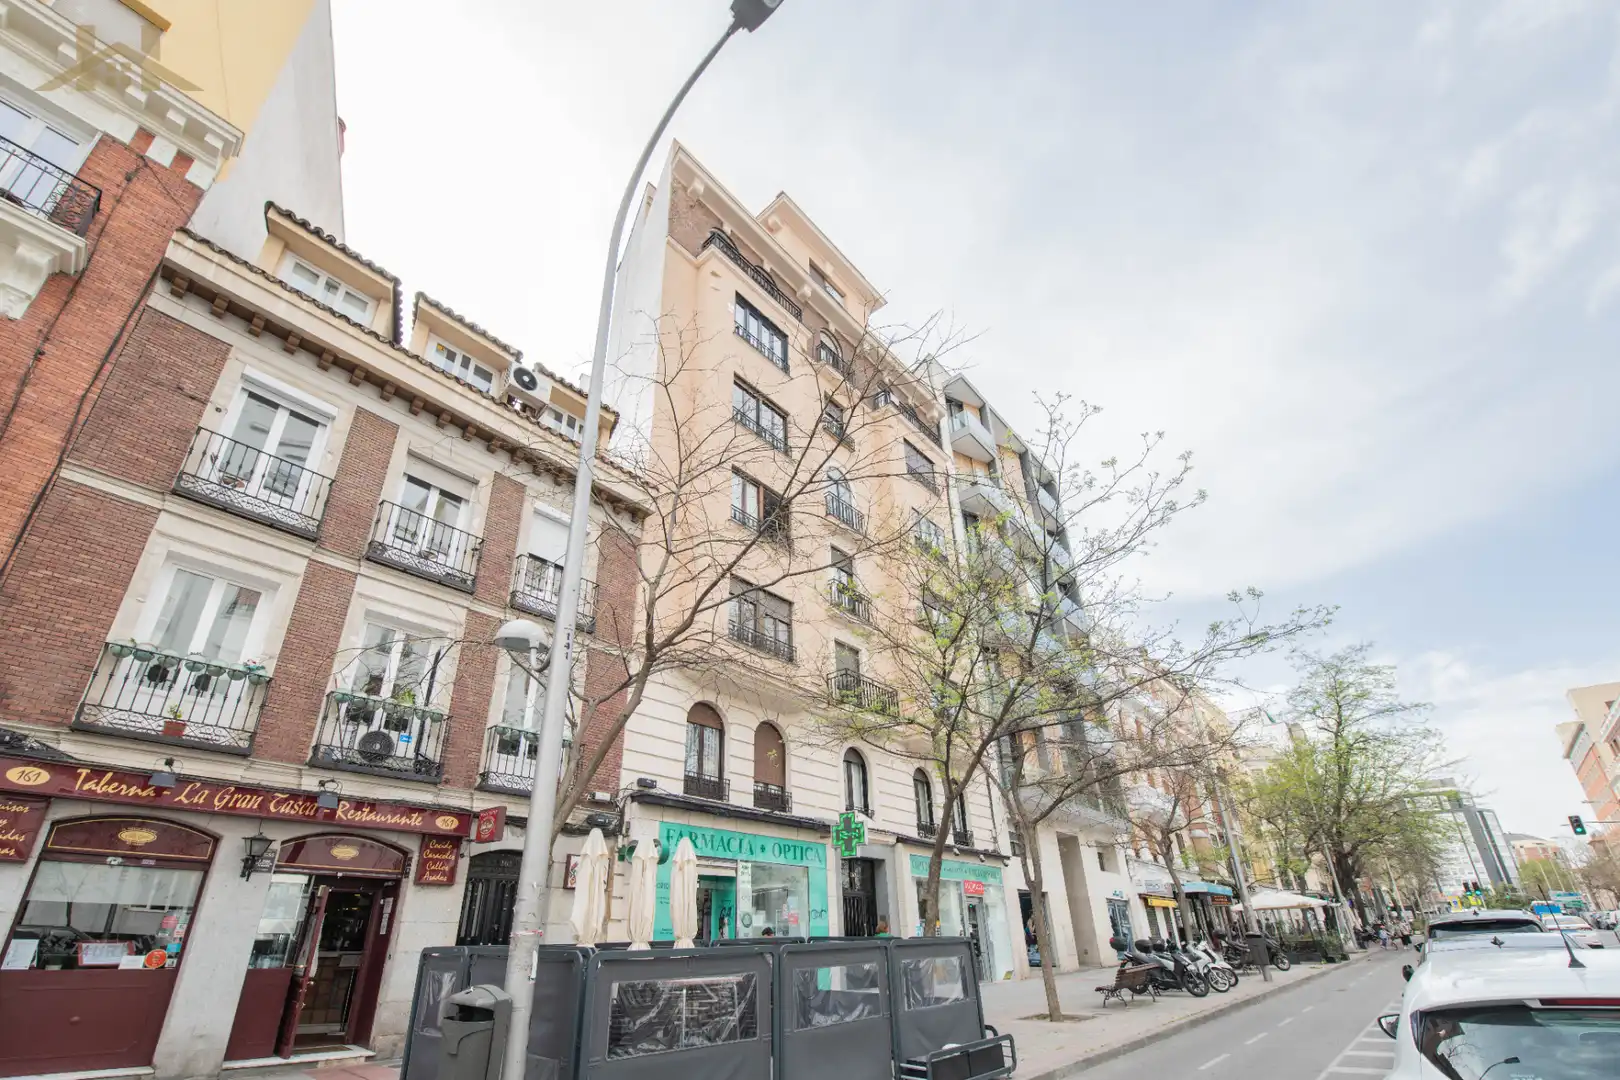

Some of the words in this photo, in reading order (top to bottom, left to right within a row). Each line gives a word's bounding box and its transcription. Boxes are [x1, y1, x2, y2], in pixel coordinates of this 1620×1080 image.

[16, 769, 42, 782] 161
[75, 768, 156, 797] Taberna
[173, 782, 211, 804] La
[213, 786, 264, 810] Gran
[269, 792, 318, 816] Tasca
[335, 800, 424, 826] Restaurante
[0, 801, 30, 813] uisos
[440, 816, 455, 828] 161
[429, 839, 453, 850] Cocido
[666, 828, 754, 856] FARMACIA
[772, 842, 822, 864] OPTICA
[423, 849, 456, 861] Caracoles
[426, 861, 450, 872] Callos
